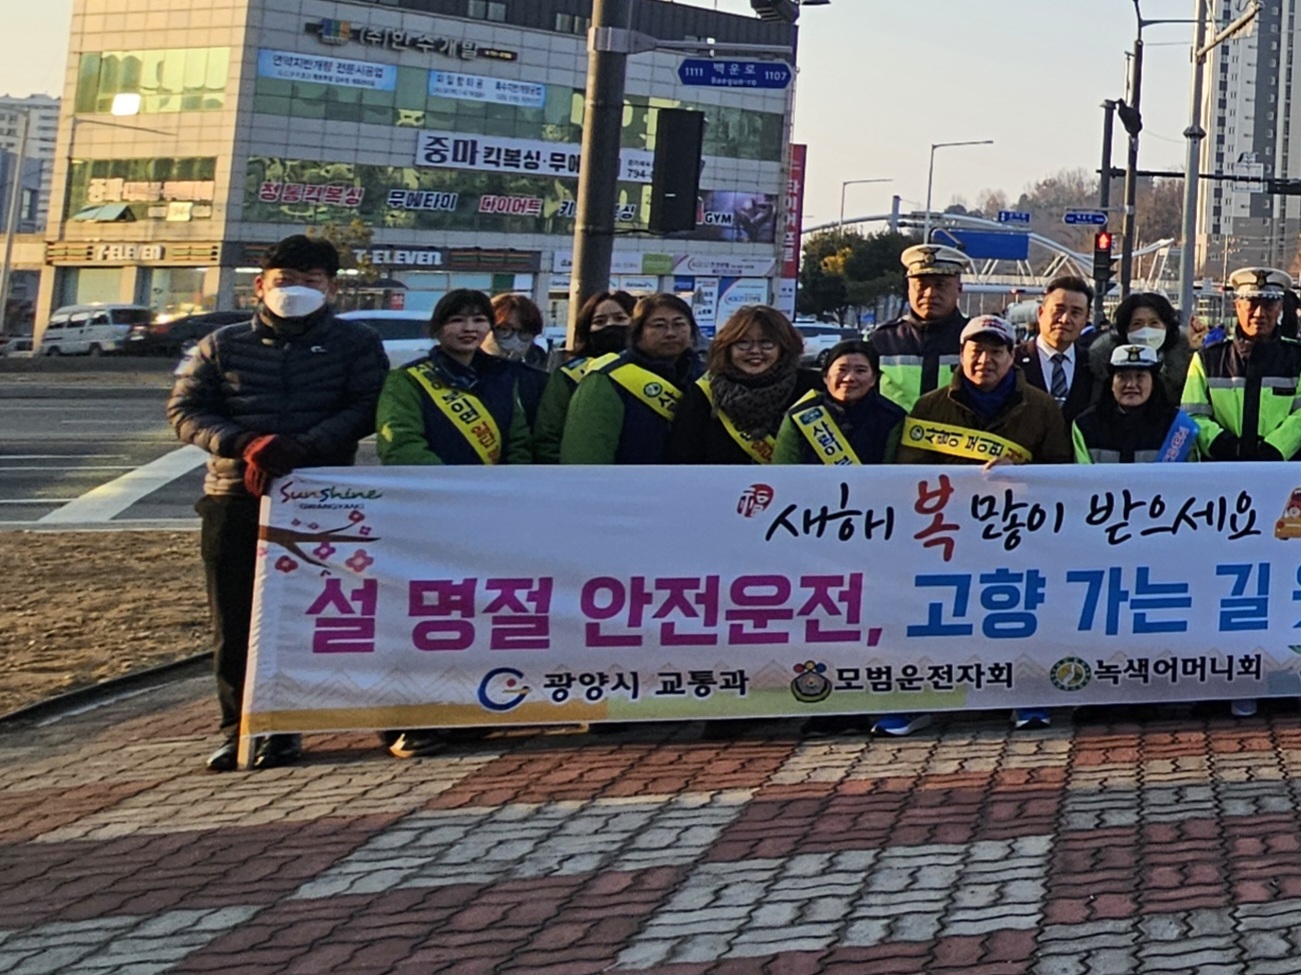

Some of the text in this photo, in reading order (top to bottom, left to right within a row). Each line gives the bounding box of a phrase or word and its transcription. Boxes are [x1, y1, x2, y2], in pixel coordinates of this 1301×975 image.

[684, 67, 703, 76] 1111
[713, 63, 756, 75] 백운로
[764, 71, 787, 81] 1107
[424, 135, 480, 166] 중마
[260, 182, 365, 207] 정통킥복싱
[388, 189, 457, 211] 무에타이
[479, 195, 544, 216] 다이어트
[704, 211, 733, 224] GYM
[813, 421, 843, 456] 사람이
[926, 427, 964, 448] 사람이
[280, 481, 383, 504] Sunshine
[765, 474, 1262, 561] 새해 복 많이 받으세요
[305, 570, 379, 654] 설
[406, 576, 554, 652] 명절
[580, 571, 883, 649] 안전운전,
[906, 567, 1046, 639] 고향
[1065, 568, 1190, 636] 가는
[1215, 561, 1274, 633] 길
[834, 662, 1013, 693] 모범운전자회
[1094, 654, 1262, 685] 녹색어머니회
[543, 668, 750, 701] 광양시 교통과
